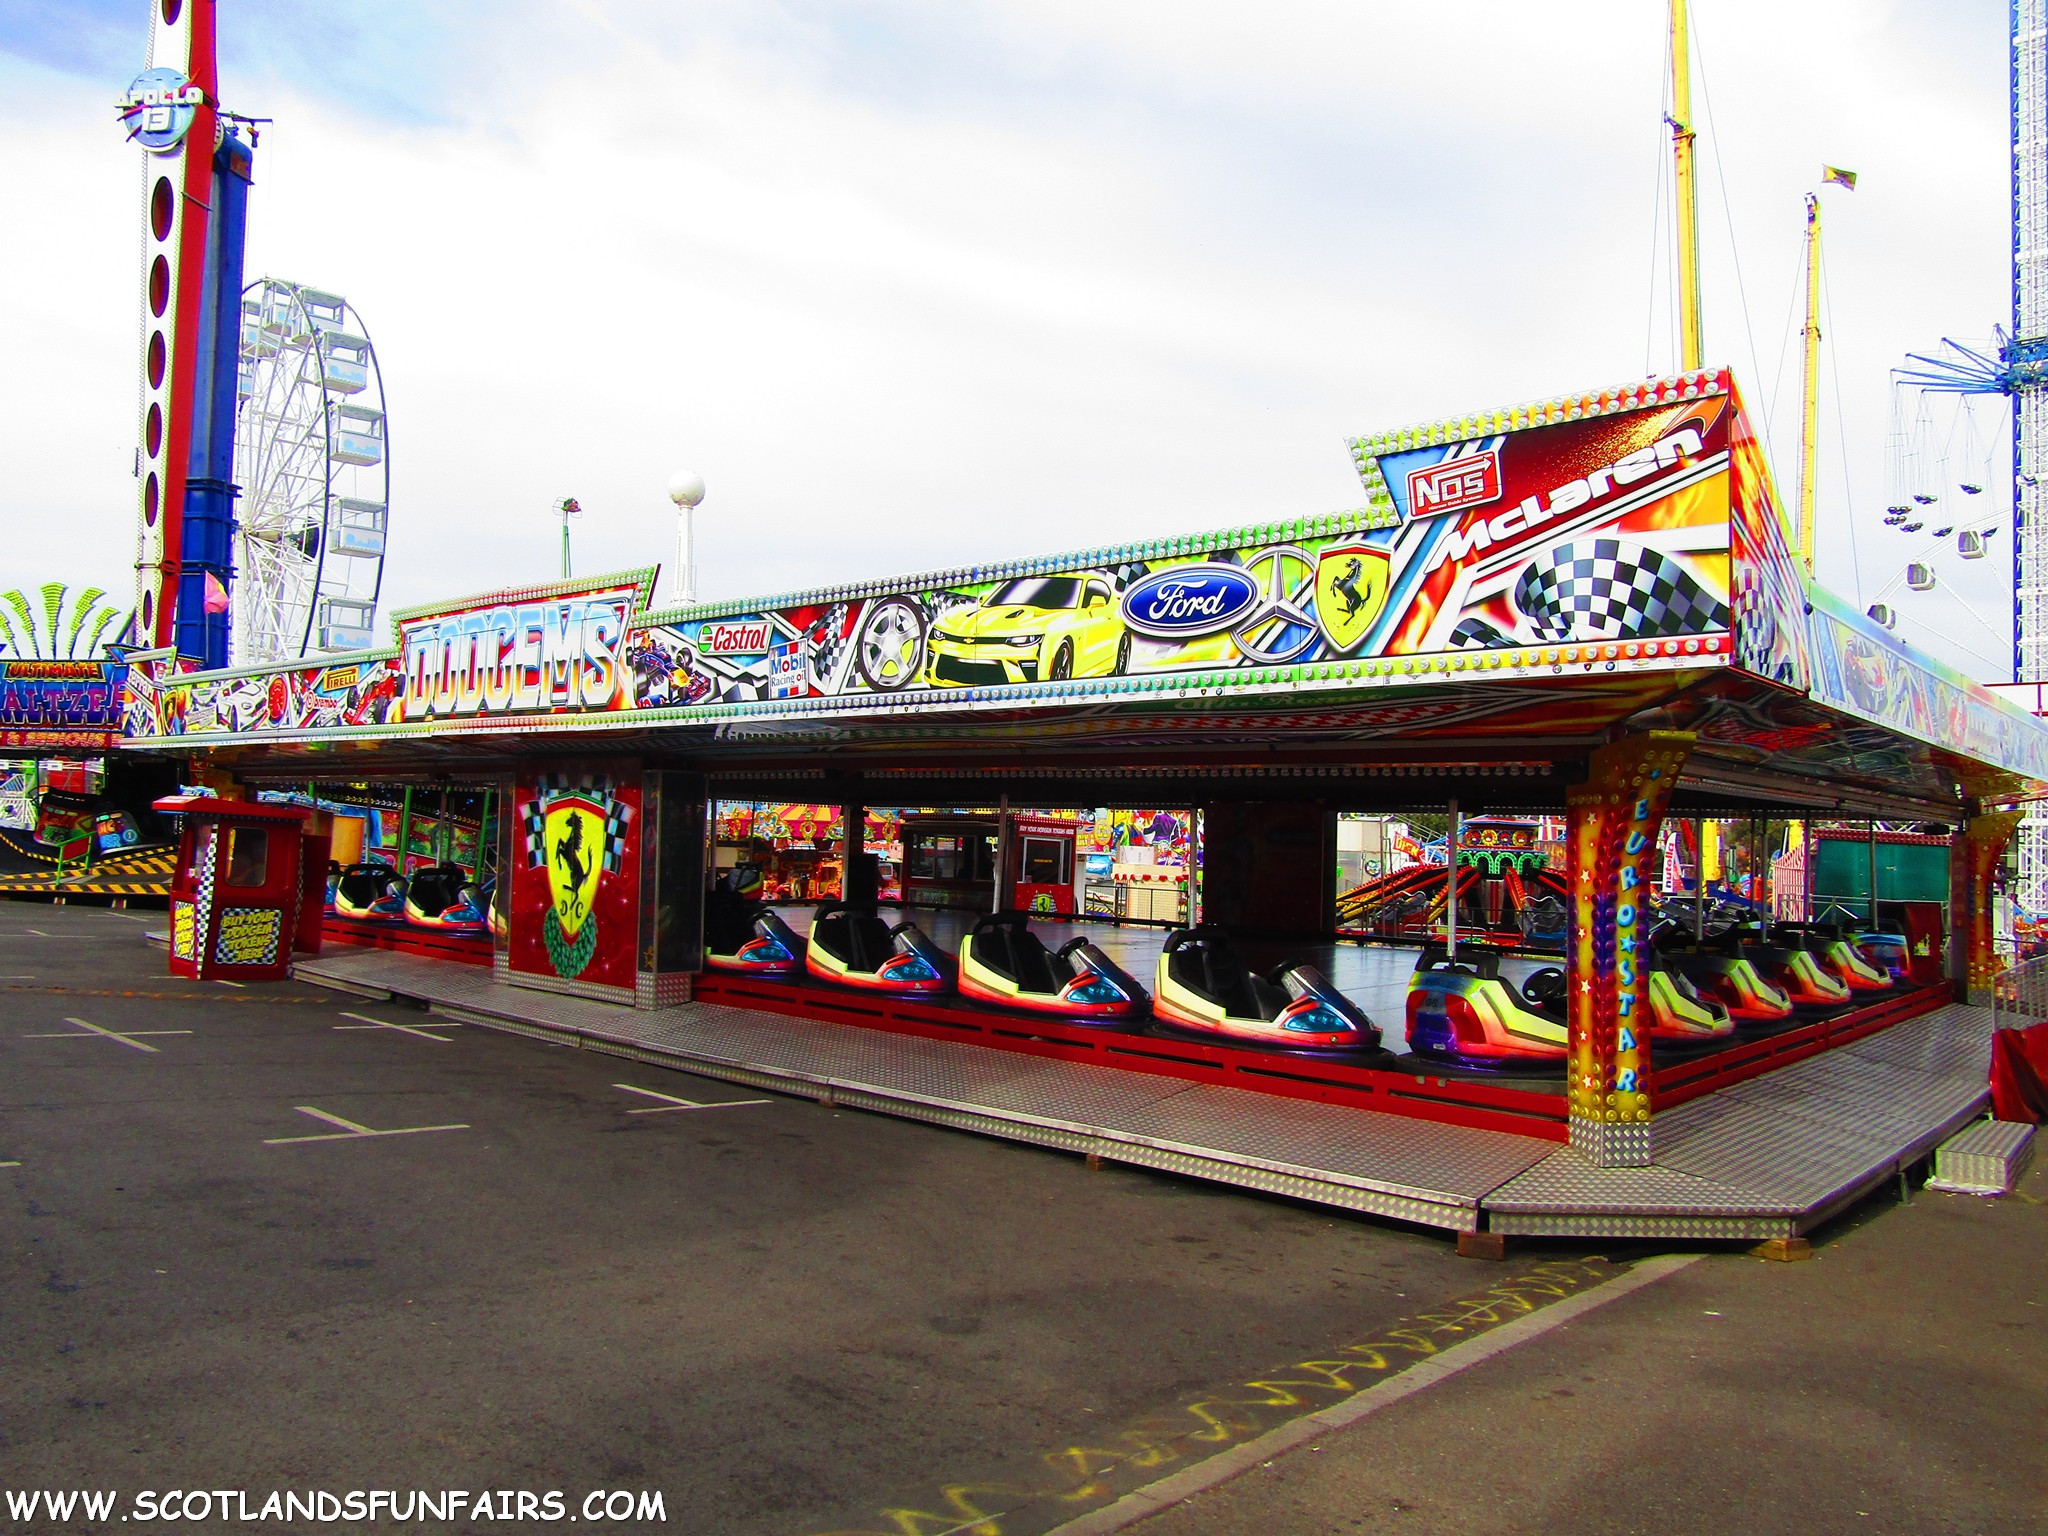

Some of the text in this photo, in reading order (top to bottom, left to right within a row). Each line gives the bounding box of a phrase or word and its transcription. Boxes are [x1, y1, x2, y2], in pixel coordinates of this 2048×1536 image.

[112, 87, 204, 107] APOLLO
[141, 107, 172, 132] 13
[1415, 457, 1492, 508] NOS
[1423, 428, 1704, 575] McLaren
[1148, 579, 1228, 620] Ford
[712, 624, 768, 652] Castrol
[9, 662, 99, 678] ULTIMATE
[405, 602, 622, 717] DODGEMS
[771, 652, 806, 676] Mobil
[326, 667, 357, 690] PIRELLI
[771, 675, 795, 687] Racing
[1395, 837, 1419, 857] OPEN
[1664, 842, 1675, 889] nutella
[222, 911, 276, 928] BUY YOUR
[225, 922, 273, 939] DODGEM
[229, 935, 271, 951] TOKENS
[236, 946, 264, 960] HERE
